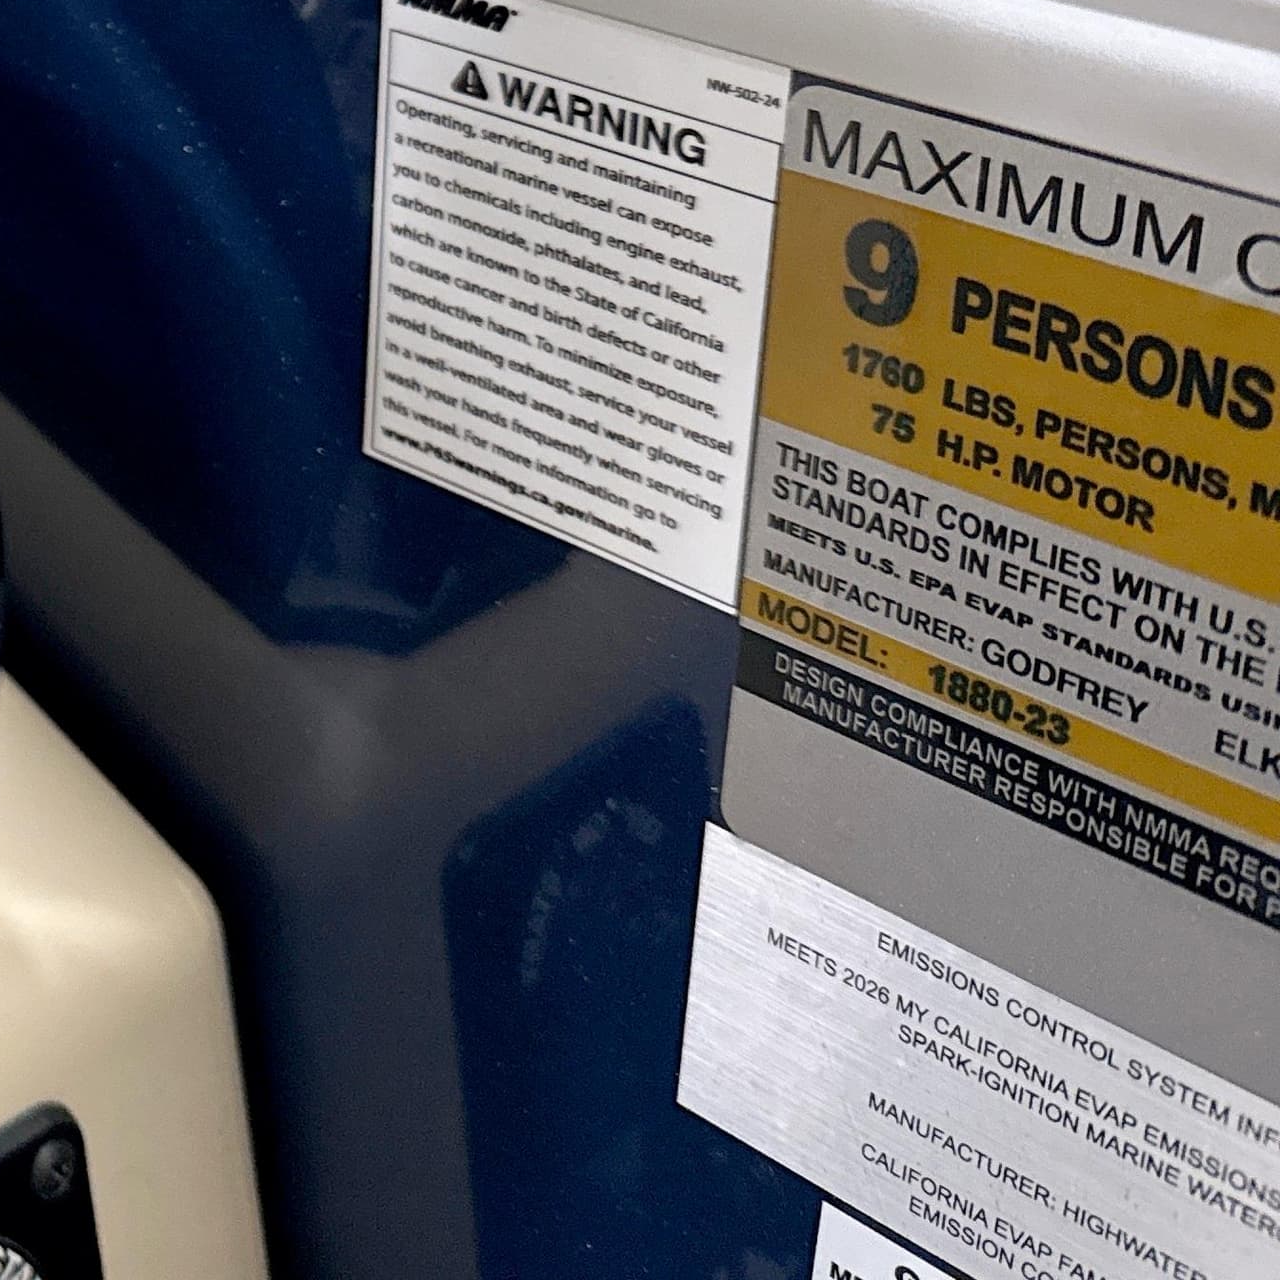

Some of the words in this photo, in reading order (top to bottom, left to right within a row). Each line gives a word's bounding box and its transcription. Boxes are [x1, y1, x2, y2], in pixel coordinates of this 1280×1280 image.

[396, 98, 478, 139] Operating,
[481, 128, 554, 165] servicing
[556, 152, 590, 173] and
[592, 164, 697, 211] maintaining
[406, 136, 499, 176] recreational
[501, 167, 560, 196] marine
[561, 187, 614, 214] vessel
[616, 205, 648, 225] can
[650, 217, 715, 248] expose
[498, 72, 706, 167] WARNING
[803, 108, 1205, 275] MAXIMUM
[390, 223, 436, 248] which
[438, 240, 464, 258] are
[465, 246, 520, 279] known
[523, 268, 541, 286] to
[543, 276, 573, 298] the
[574, 285, 619, 314] State
[620, 306, 641, 322] of
[642, 311, 725, 353] California
[391, 193, 445, 220] carbon
[447, 212, 530, 253] monoxide,
[533, 242, 626, 286] phthalates,
[627, 276, 662, 297] and
[664, 284, 708, 315] lead,
[392, 163, 422, 182] you
[424, 171, 442, 188] to
[443, 179, 523, 216] chemicals
[524, 204, 603, 247] including
[605, 235, 667, 265] engine
[668, 257, 743, 293] exhaust,
[389, 251, 406, 268] to
[407, 260, 452, 285] cause
[453, 277, 507, 304] cancer
[508, 297, 540, 318] and
[542, 305, 583, 334] birth
[586, 324, 648, 358] defects
[649, 350, 671, 365] or
[672, 358, 722, 384] other
[842, 217, 921, 328] 9
[951, 276, 1276, 431] PERSONS
[843, 342, 925, 395] 1760
[941, 377, 1025, 437] LBS,
[1034, 408, 1238, 511] PERSONS,
[871, 403, 916, 444] 75
[936, 428, 1002, 478] H.P.
[1011, 454, 1155, 534] MOTOR
[767, 512, 847, 557] MEETS
[854, 547, 901, 580] U.S.
[908, 568, 957, 602] EPA
[964, 591, 1034, 629] EVAP
[1041, 622, 1212, 702] STANDARDS
[772, 474, 951, 563] STANDARDS
[959, 544, 990, 580] IN
[998, 559, 1128, 630] EFFECT
[1134, 614, 1186, 656] ON
[1195, 634, 1267, 687] THE
[775, 441, 839, 487] THIS
[846, 468, 930, 519] BOAT
[936, 503, 1102, 586] COMPLIES
[1112, 566, 1199, 624] WITH
[1209, 603, 1275, 654] U.S.
[758, 591, 889, 670] MODEL:
[928, 663, 1071, 746] 1880-23
[763, 548, 975, 653] MANUFACTURER:
[980, 638, 1149, 724] GODFREY
[774, 651, 864, 708] DESIGN
[870, 694, 1040, 786] COMPLIANCE
[1048, 769, 1117, 819] WITH
[1124, 803, 1211, 862] NMMA
[782, 681, 987, 790] MANUFACTURER
[993, 773, 1188, 880] RESPONSIBLE
[1195, 864, 1258, 911] FOR
[767, 927, 838, 978] MEETS
[842, 967, 890, 1006] 2026
[895, 993, 930, 1024] MY
[933, 1015, 1070, 1101] CALIFORNIA
[1074, 1087, 1138, 1130] EVAP
[877, 931, 1000, 1008] EMISSIONS
[1005, 998, 1120, 1071] CONTROL
[1126, 1058, 1231, 1126] SYSTEM
[1237, 1114, 1280, 1145] INF
[898, 1023, 1080, 1134] SPARK-IGNITION
[1085, 1122, 1181, 1188] MARINE
[861, 1142, 989, 1229] CALIFORNIA
[993, 1216, 1053, 1259] EVAP
[868, 1091, 1056, 1211] MANUFACTURER:
[908, 1194, 1016, 1270] EMISSION
